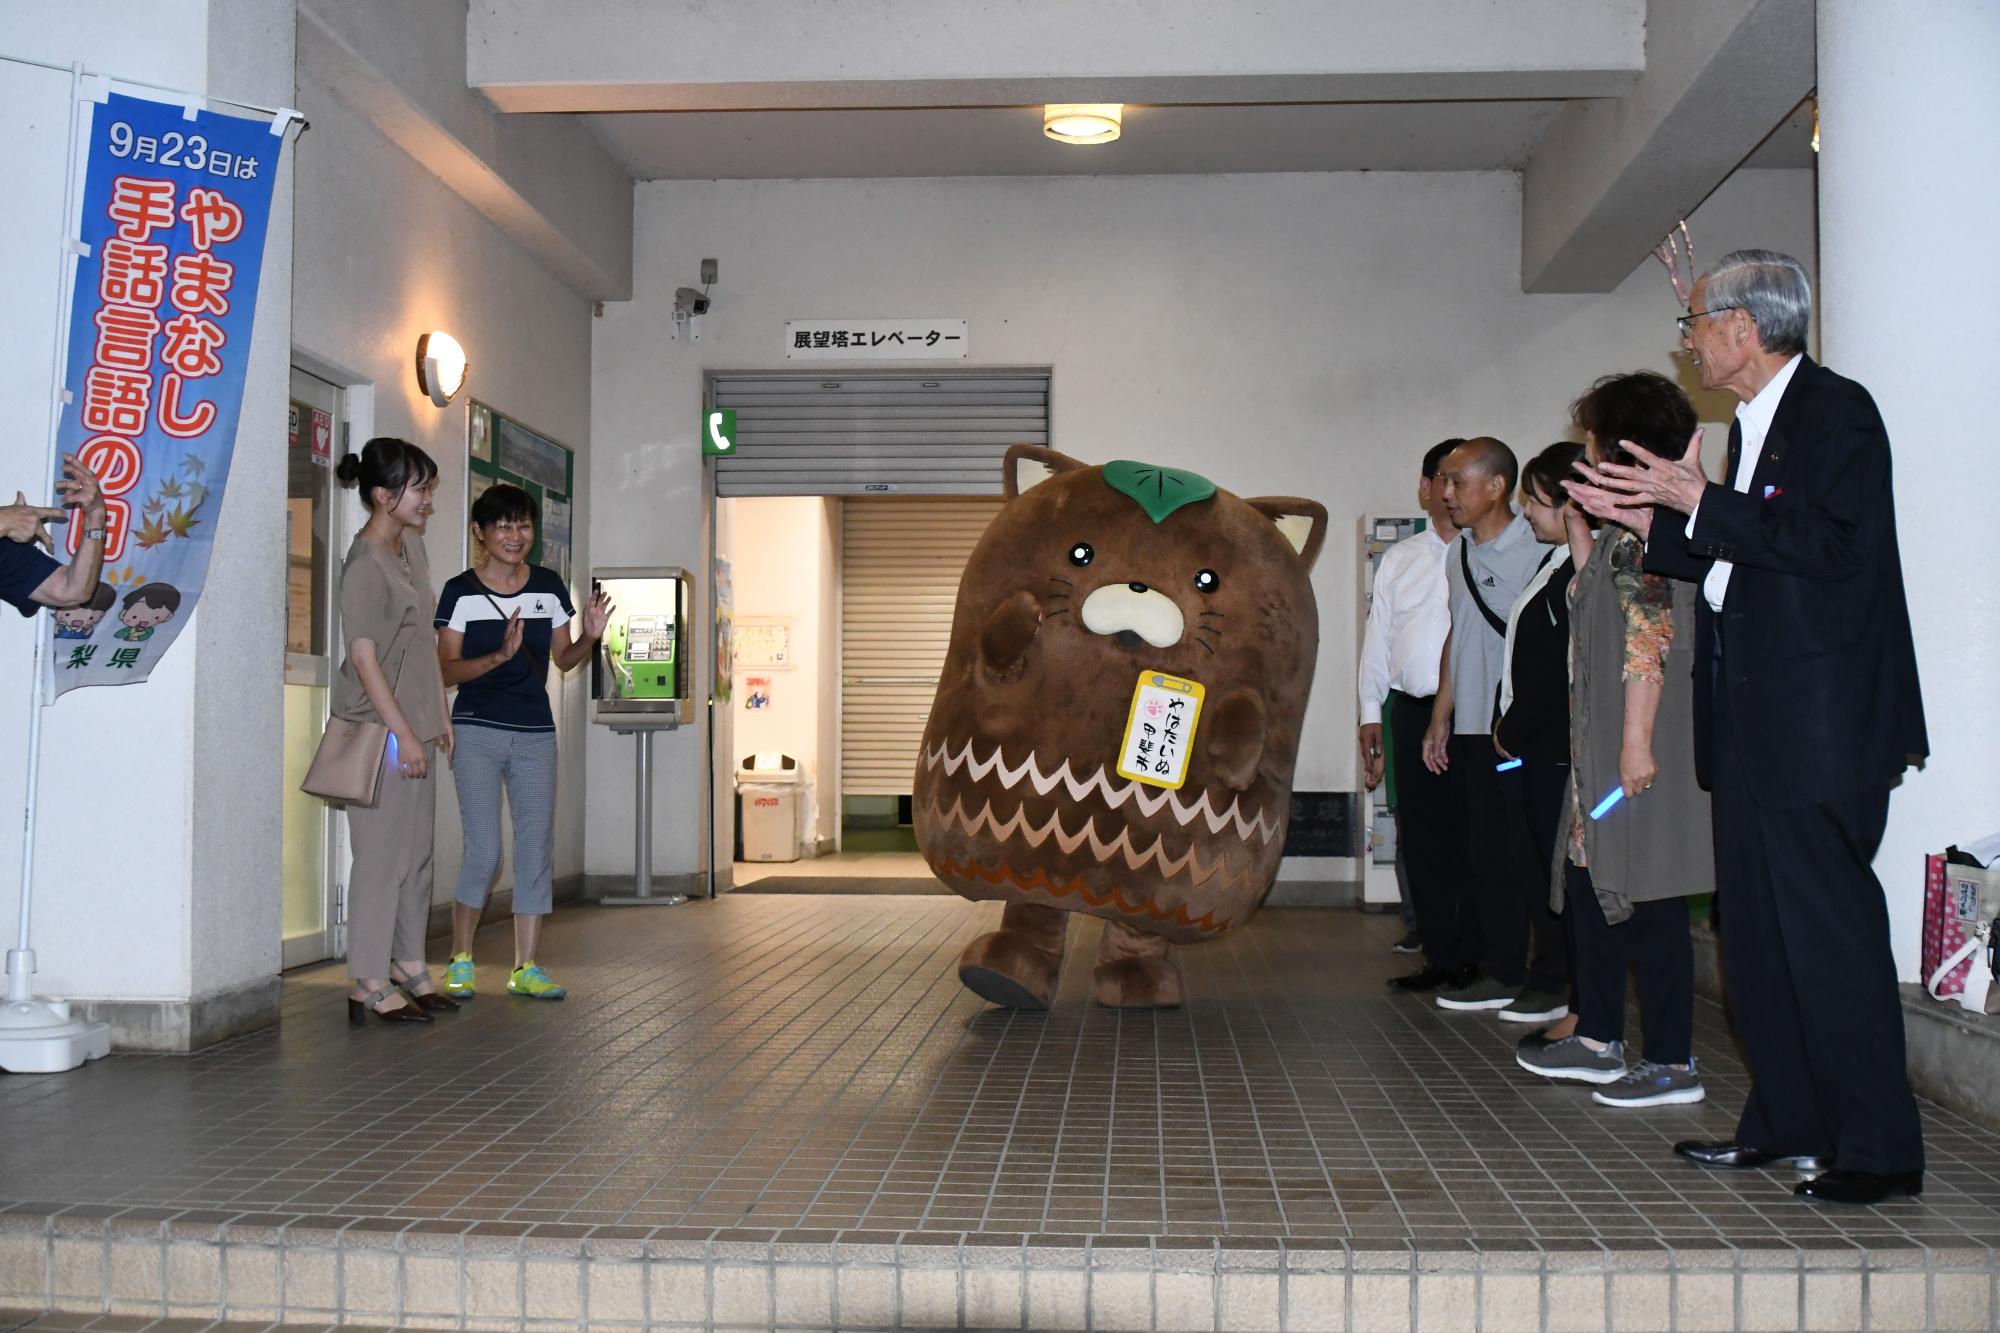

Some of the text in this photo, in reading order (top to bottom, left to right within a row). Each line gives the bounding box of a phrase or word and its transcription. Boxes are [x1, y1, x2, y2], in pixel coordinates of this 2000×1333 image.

[108, 121, 259, 180] 9月23日は
[157, 187, 243, 439] やまなし
[793, 329, 961, 349] 展望塔エレベーター
[314, 412, 330, 428] AED
[1154, 697, 1185, 776] やはたいぬ
